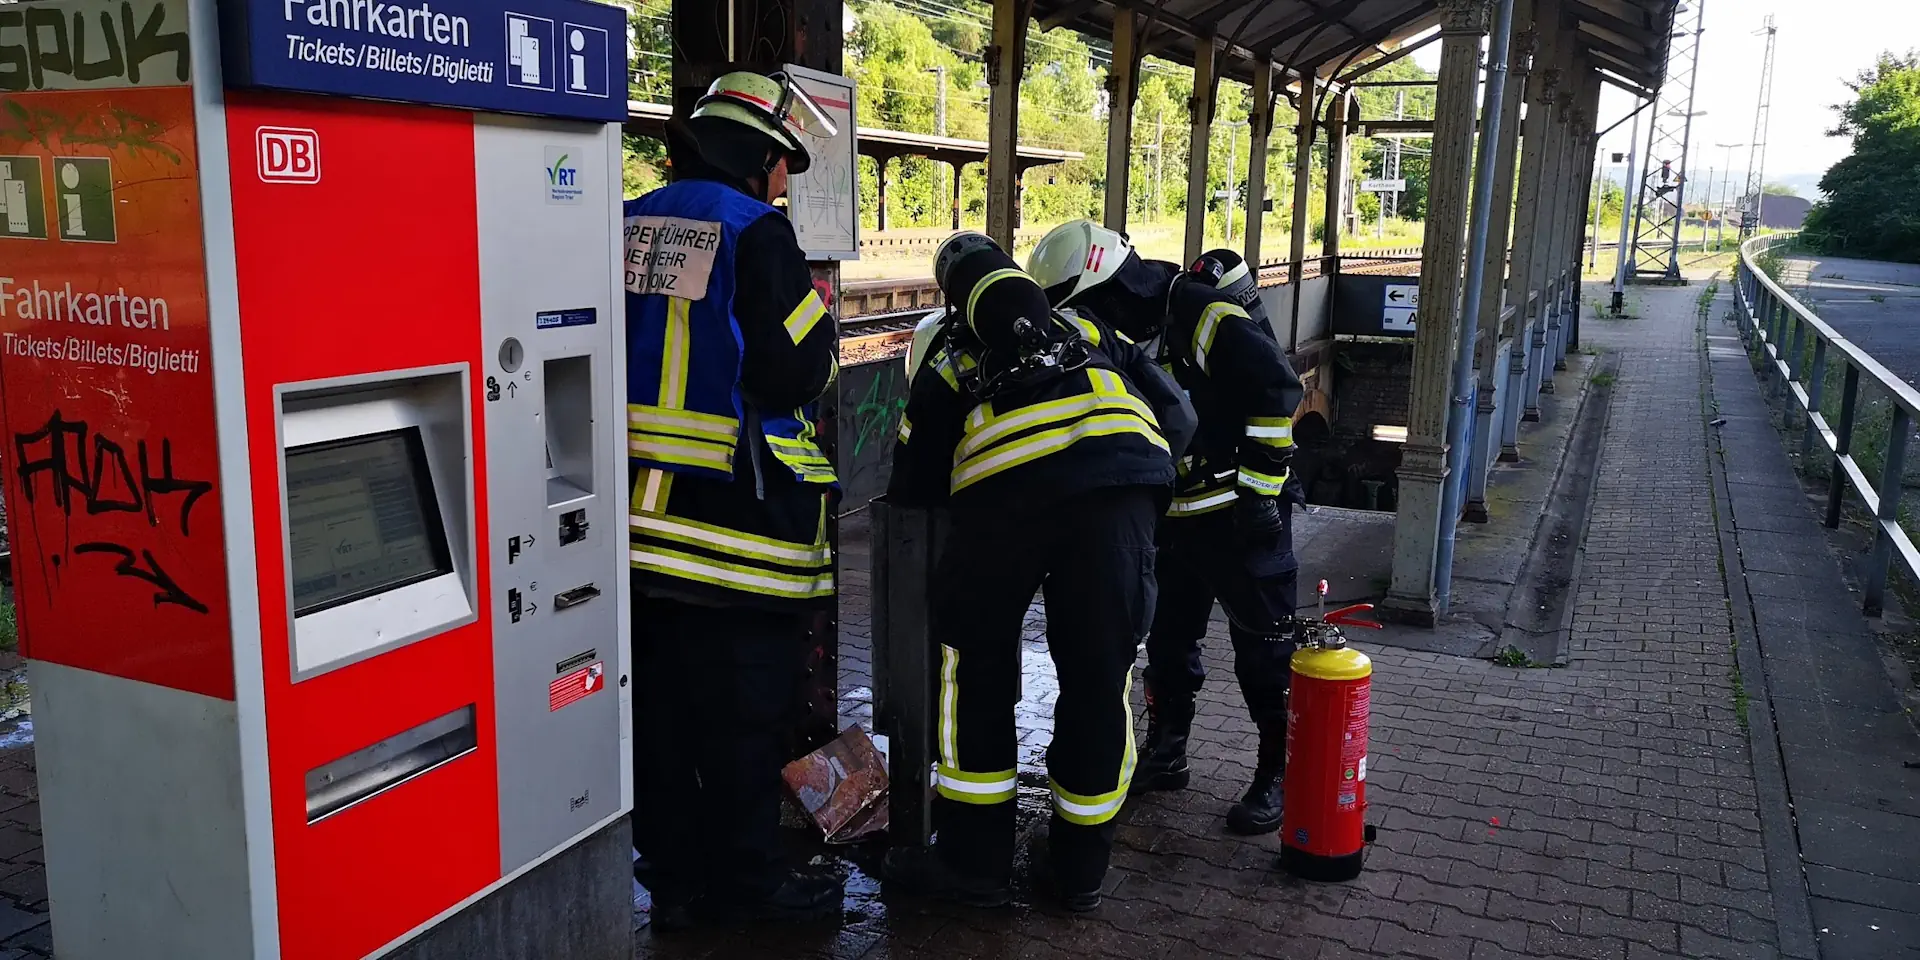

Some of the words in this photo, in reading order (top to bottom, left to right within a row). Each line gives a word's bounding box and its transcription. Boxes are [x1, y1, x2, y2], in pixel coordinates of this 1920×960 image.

[266, 137, 311, 173] DB
[546, 153, 576, 186] VRT
[0, 276, 169, 331] Fahrkarten
